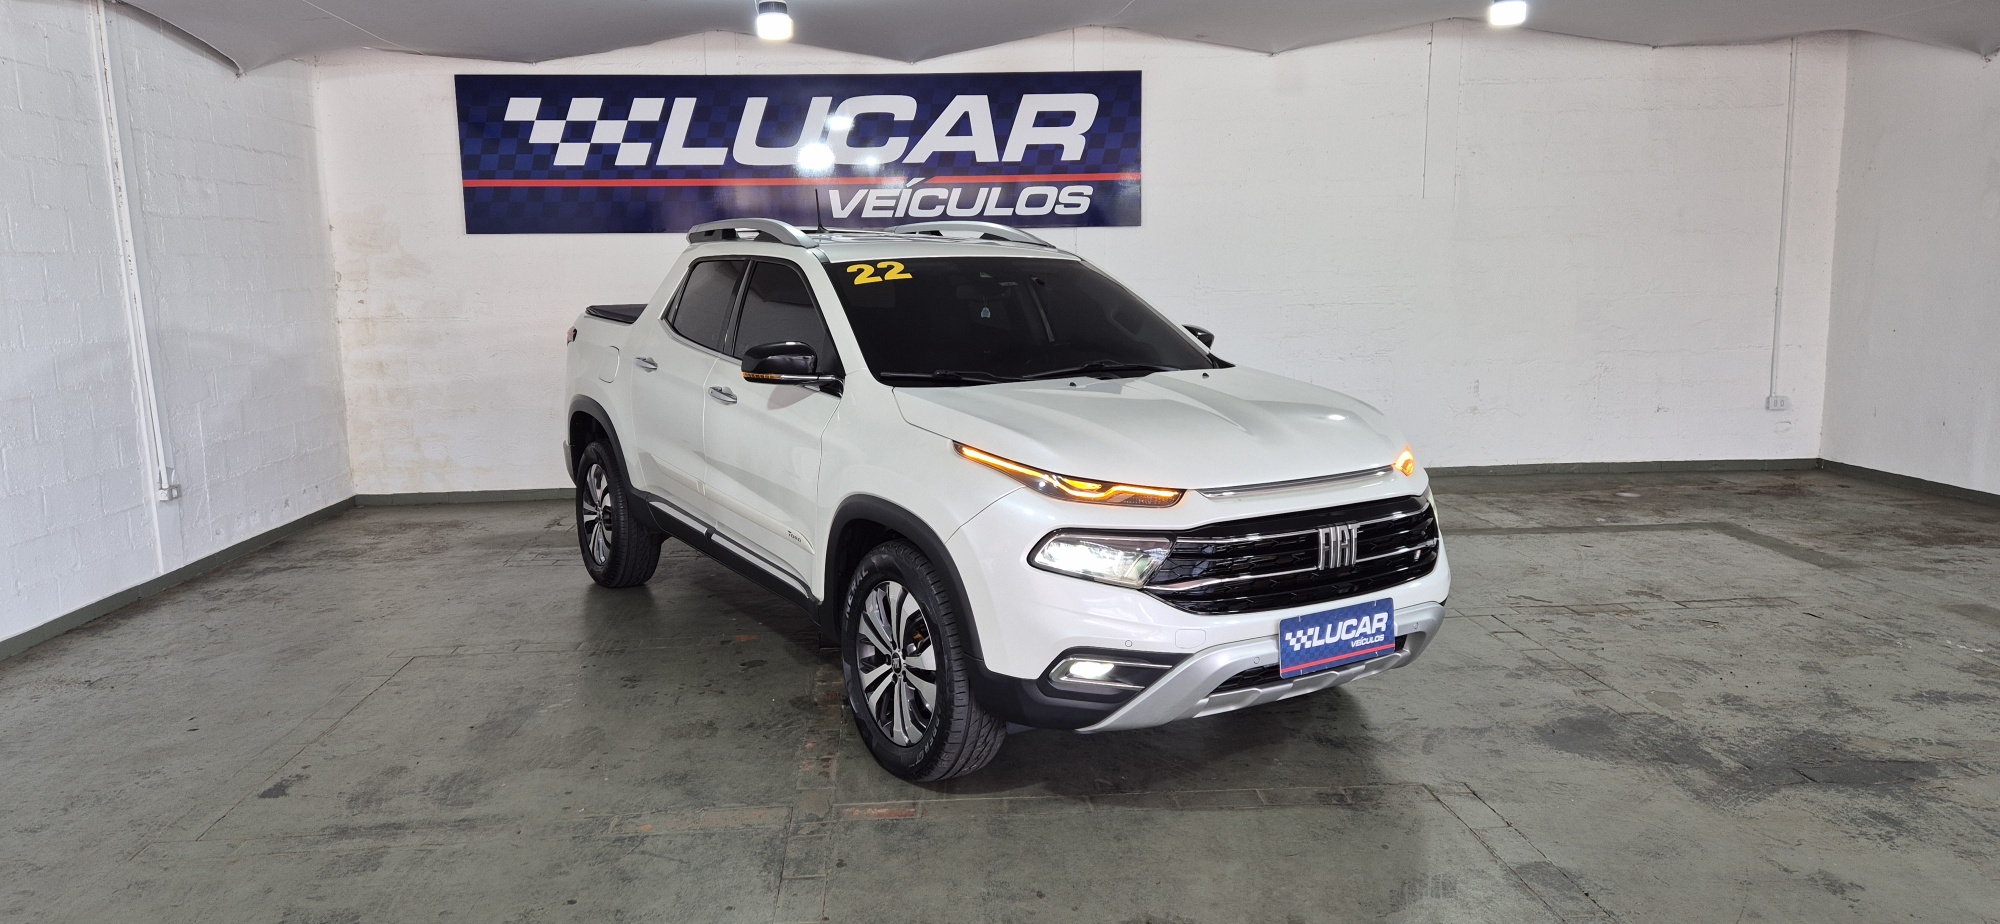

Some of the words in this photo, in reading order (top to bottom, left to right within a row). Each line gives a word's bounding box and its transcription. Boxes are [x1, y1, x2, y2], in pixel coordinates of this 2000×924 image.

[655, 93, 1100, 166] LUCAR
[828, 178, 1093, 219] VEÍCULOS
[846, 261, 913, 287] 22
[1318, 523, 1361, 571] FIAT
[1311, 612, 1388, 647] LUCAR
